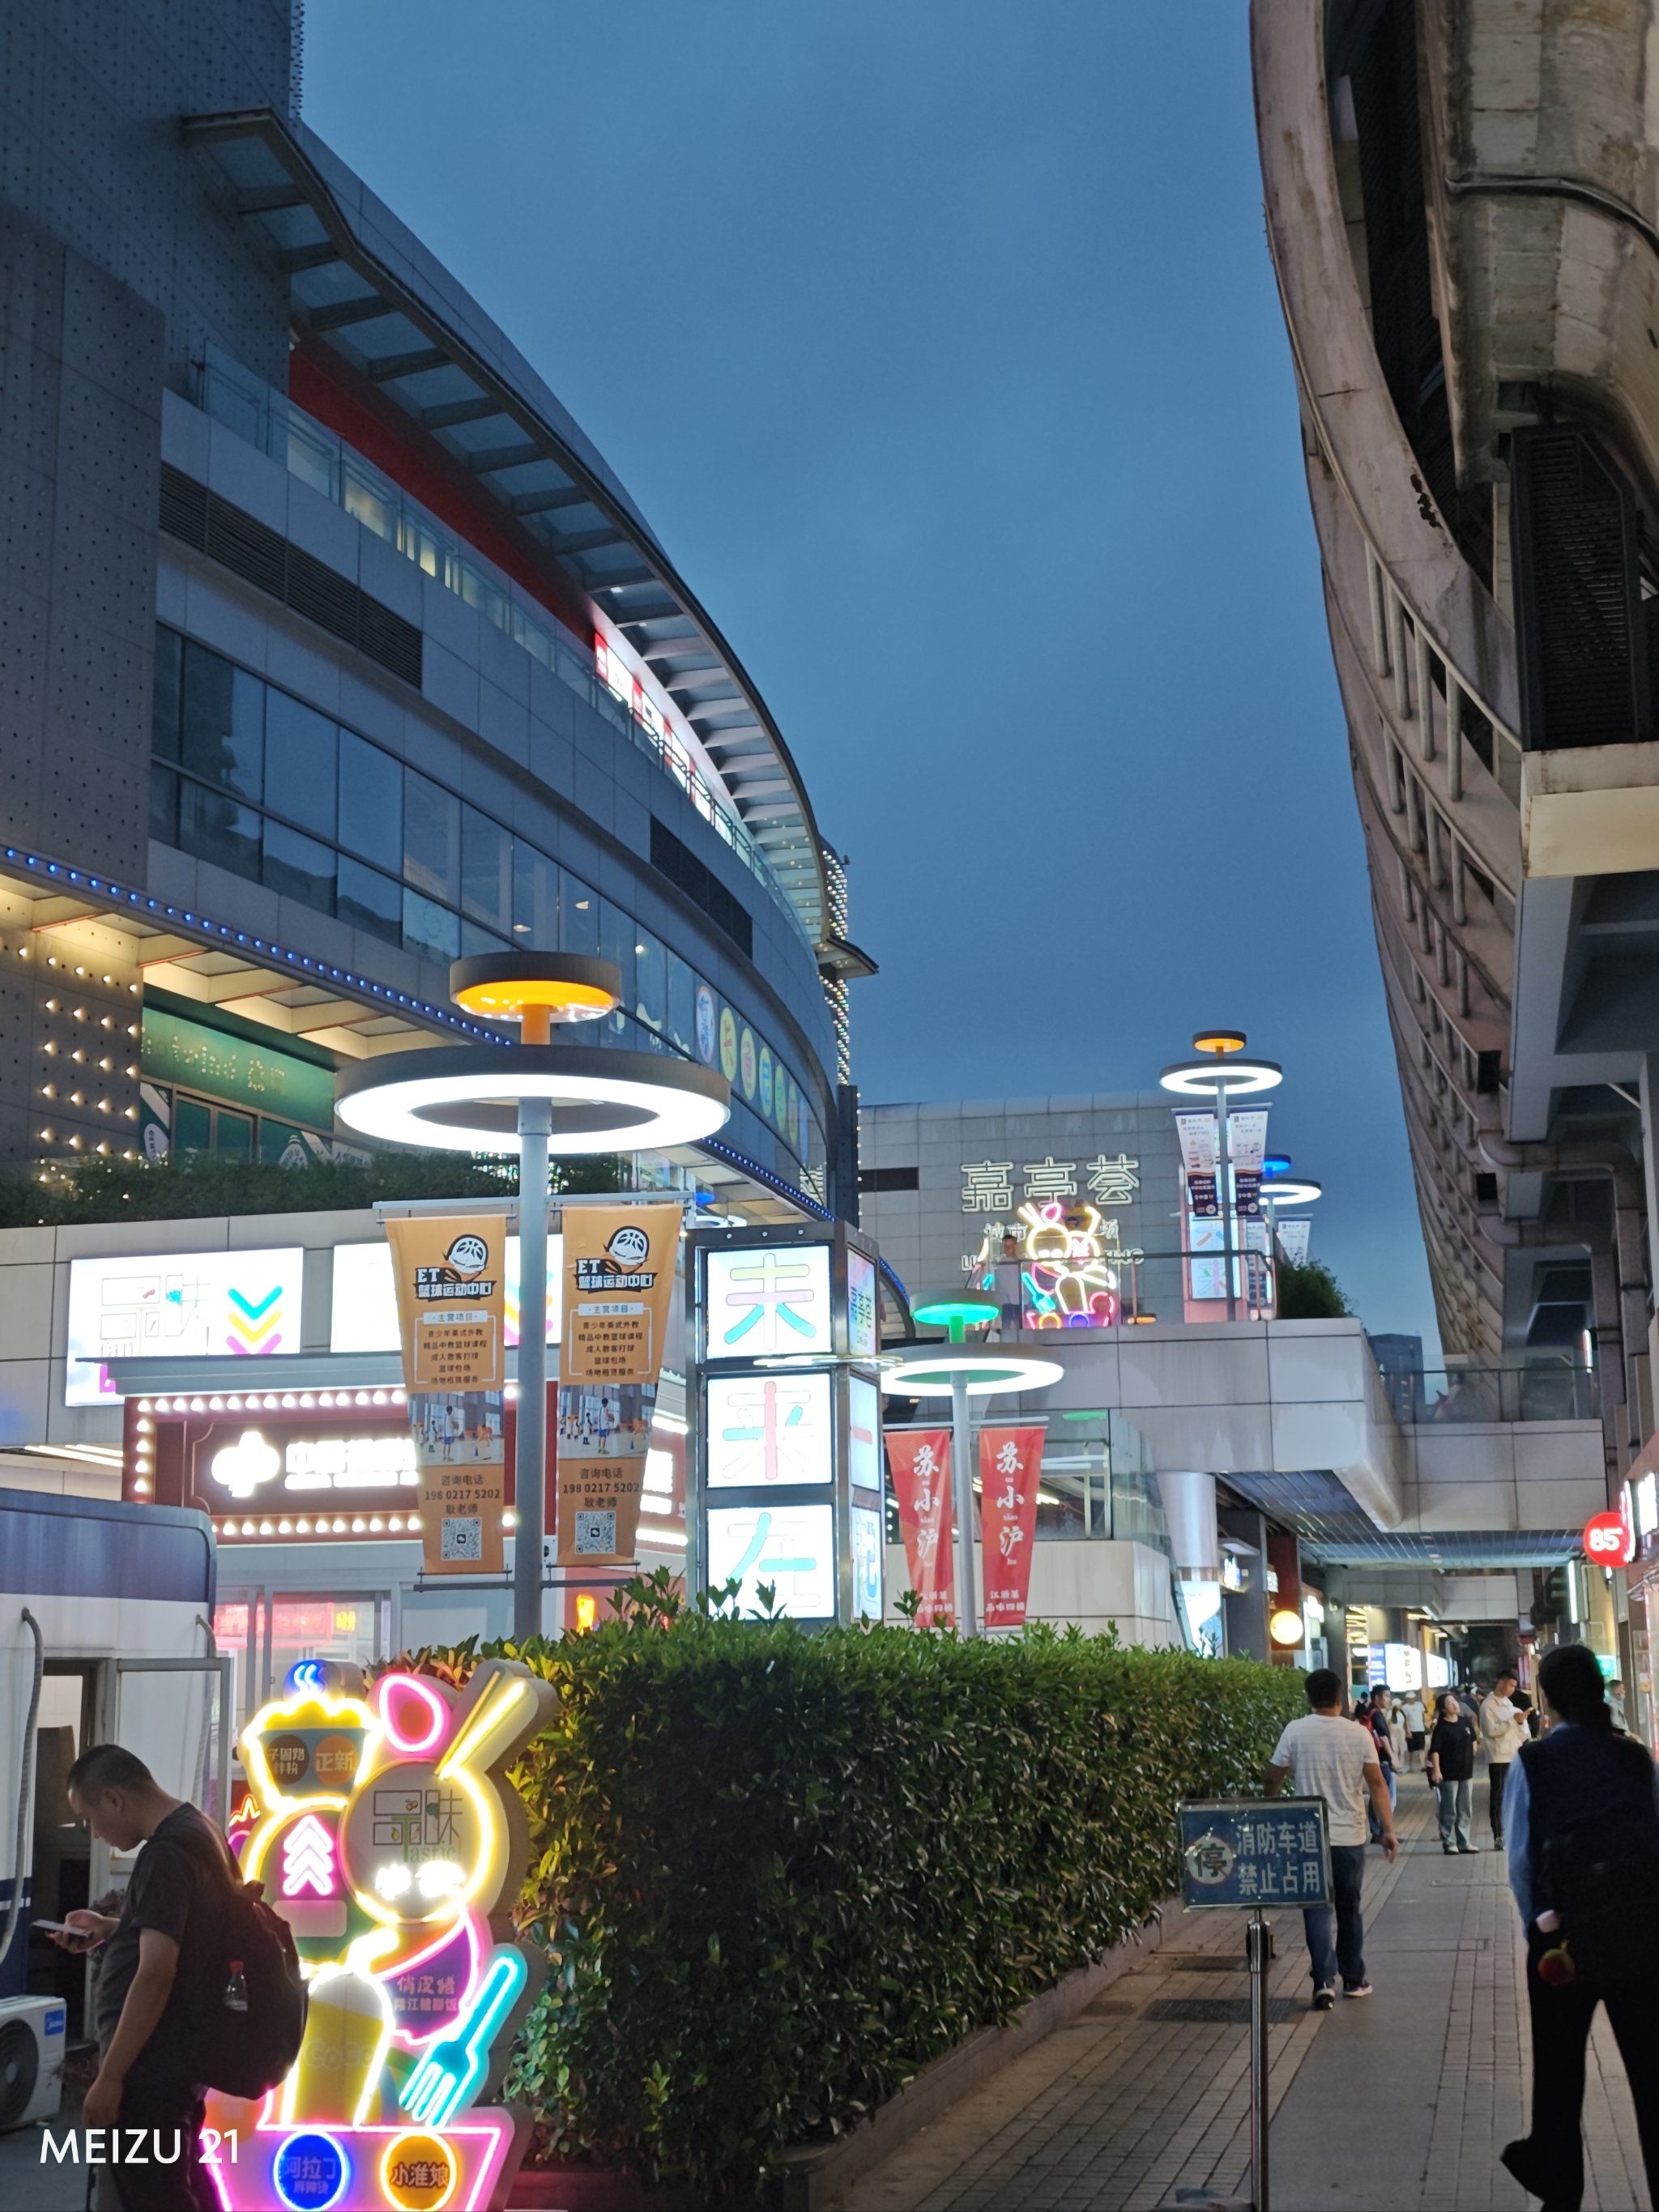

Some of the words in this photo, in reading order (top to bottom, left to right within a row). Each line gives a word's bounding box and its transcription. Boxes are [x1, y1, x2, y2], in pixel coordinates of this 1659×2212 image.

[961, 1153, 1140, 1212] 嘉亭荟
[578, 1259, 600, 1274] ET
[417, 1268, 440, 1283] ET
[578, 1274, 652, 1289] 篮球运动中心
[418, 1282, 492, 1298] 篮球运动中心
[441, 1474, 484, 1485] 咨询电话
[580, 1468, 623, 1479] 咨询电话
[425, 1490, 443, 1500] 198
[446, 1490, 471, 1500] 0217
[475, 1489, 501, 1499] 5202
[563, 1484, 582, 1494] 198
[584, 1483, 610, 1493] 0217
[614, 1482, 639, 1492] 5202
[584, 1497, 617, 1508] 耿老师
[913, 1445, 940, 1558] 苏小沪
[996, 1441, 1025, 1557] 苏小沪
[446, 1503, 478, 1515] 耿老师
[315, 1750, 355, 1772] 正新
[1235, 1821, 1319, 1856] 消防车道
[1193, 1843, 1227, 1877] 停
[1238, 1861, 1320, 1896] 禁止占用
[390, 2162, 449, 2187] 小淮娘
